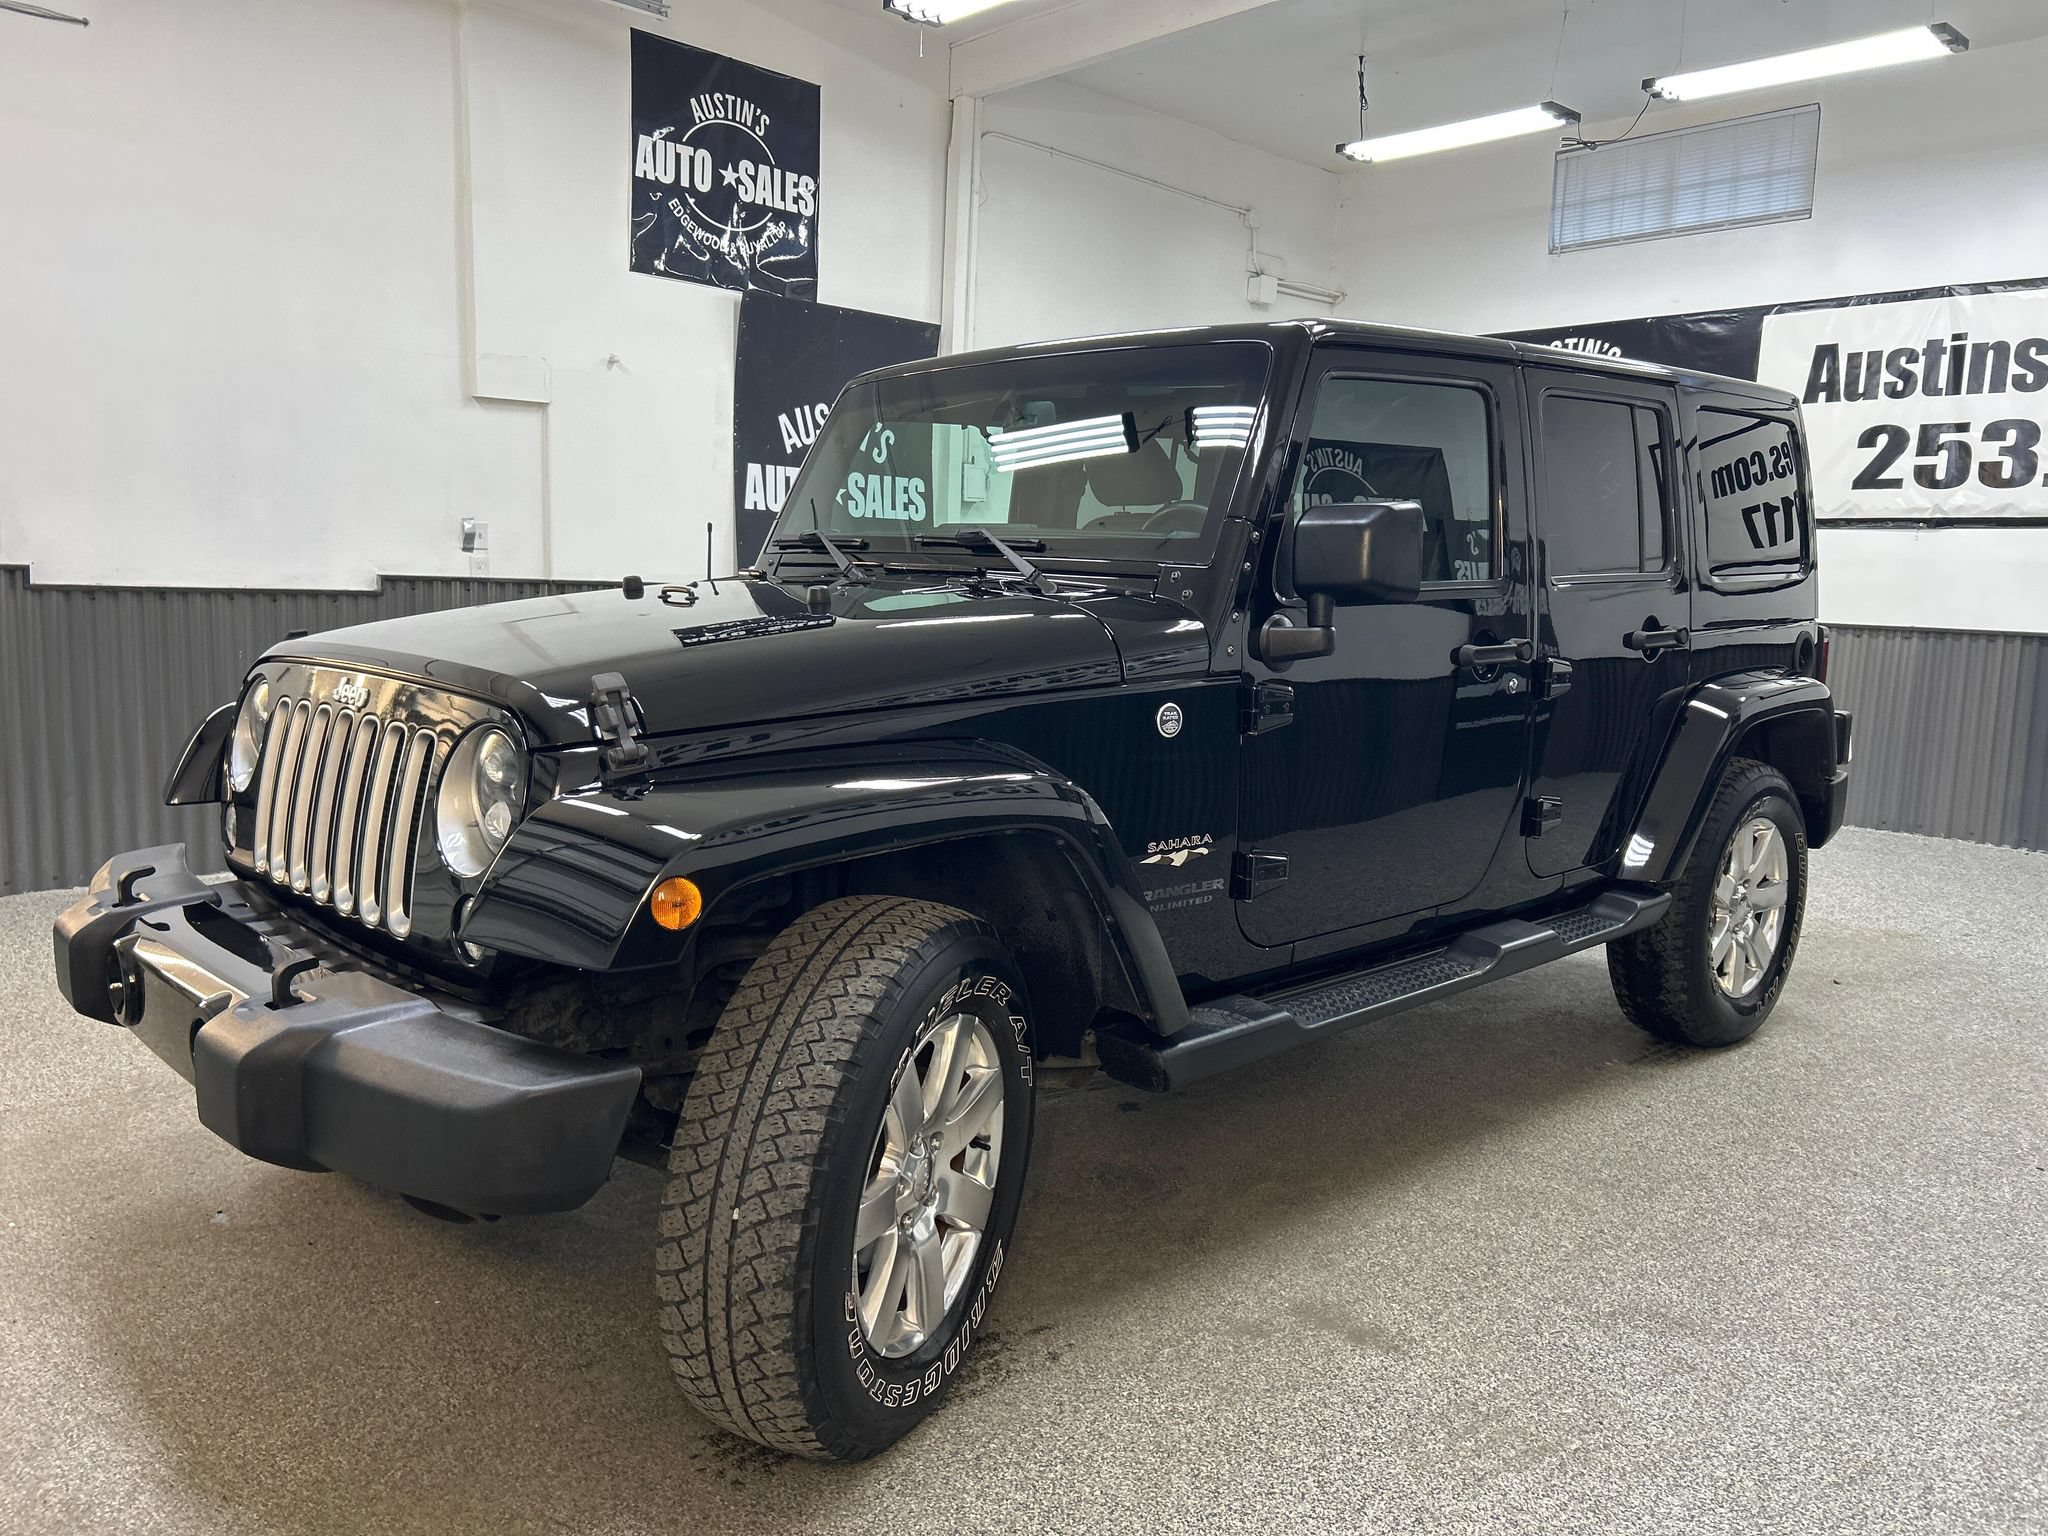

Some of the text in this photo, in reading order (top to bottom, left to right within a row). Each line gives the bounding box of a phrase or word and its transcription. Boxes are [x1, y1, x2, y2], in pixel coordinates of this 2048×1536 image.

[690, 92, 770, 137] AUSTIN'S
[635, 134, 816, 217] AUTO SALES
[1802, 332, 2048, 404] Austins
[744, 462, 926, 521] AUT SALES
[332, 676, 371, 713] Jeep
[1147, 833, 1213, 853] SAHARA
[1143, 878, 1225, 902] RANGLER
[1149, 895, 1213, 913] NLIMITED
